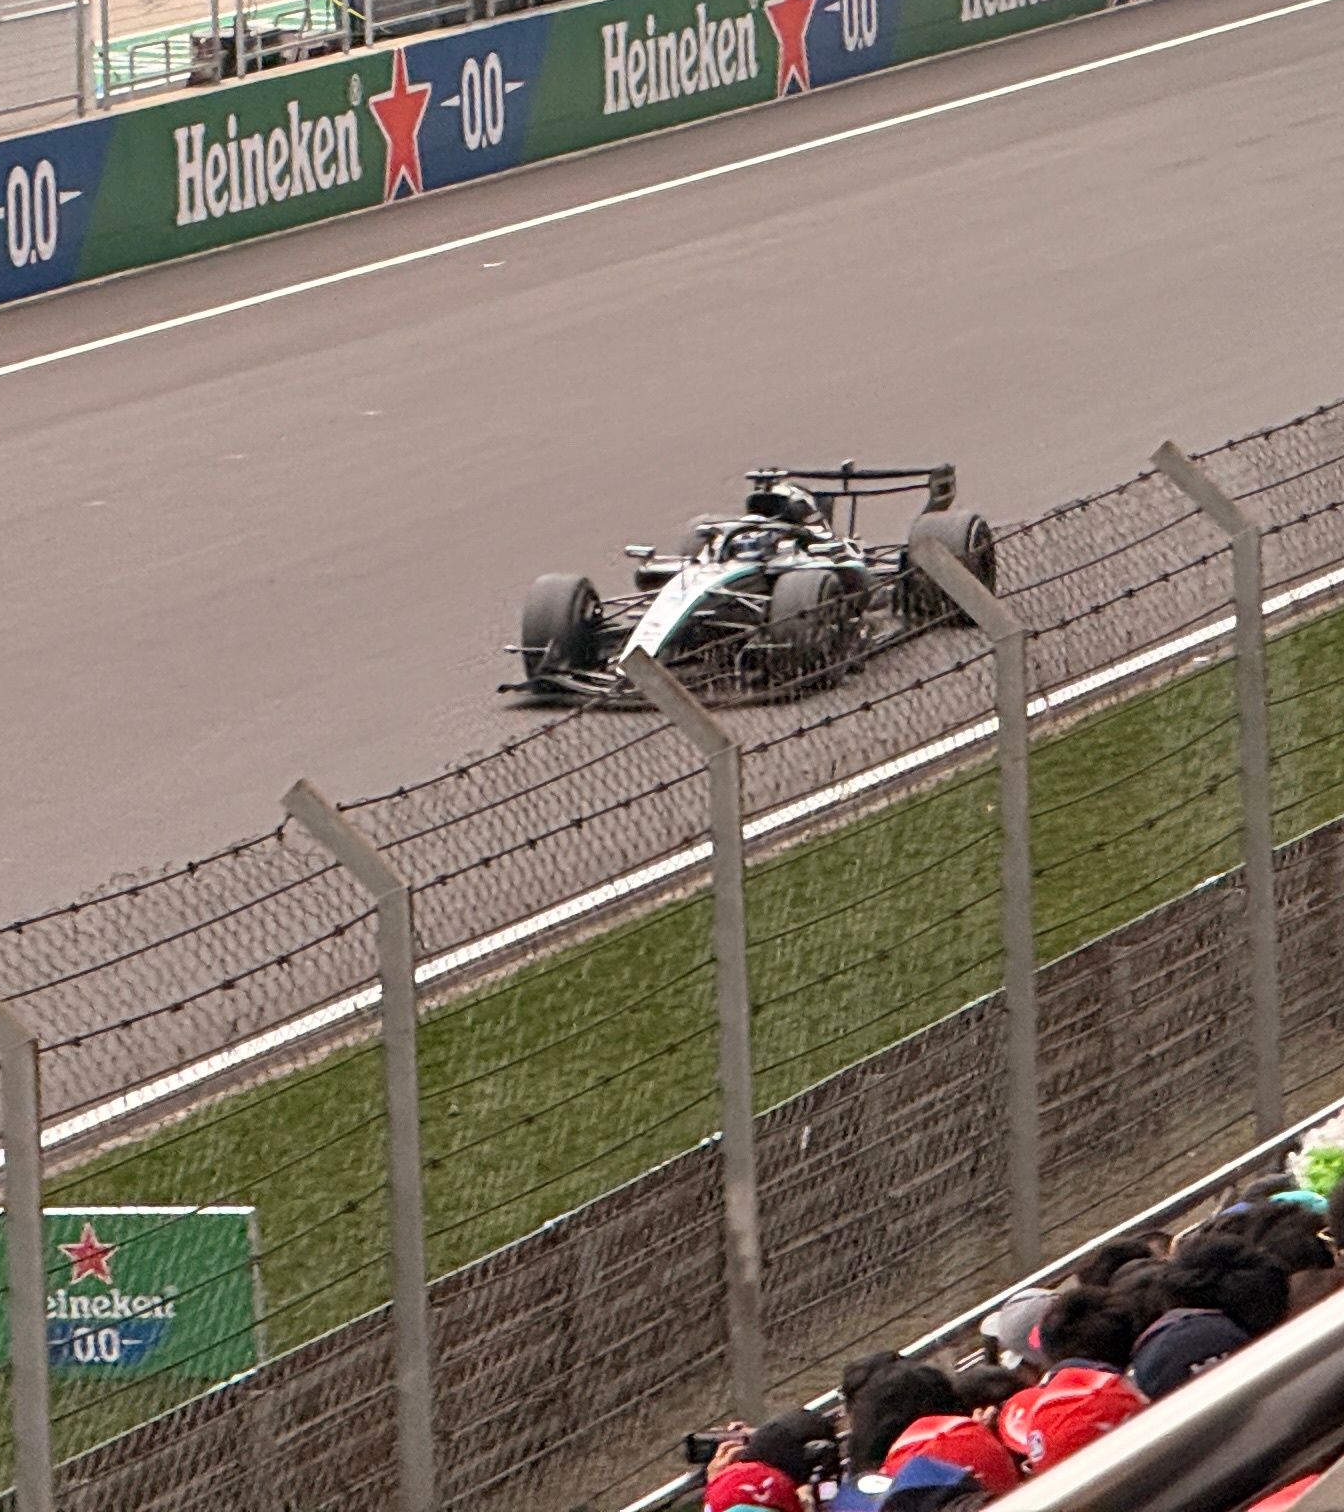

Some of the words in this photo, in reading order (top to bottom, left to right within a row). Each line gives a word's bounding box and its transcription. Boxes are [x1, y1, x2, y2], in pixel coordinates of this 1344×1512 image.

[602, 3, 760, 115] Heineken
[174, 100, 362, 227] Heineken
[45, 1288, 177, 1319] ineken
